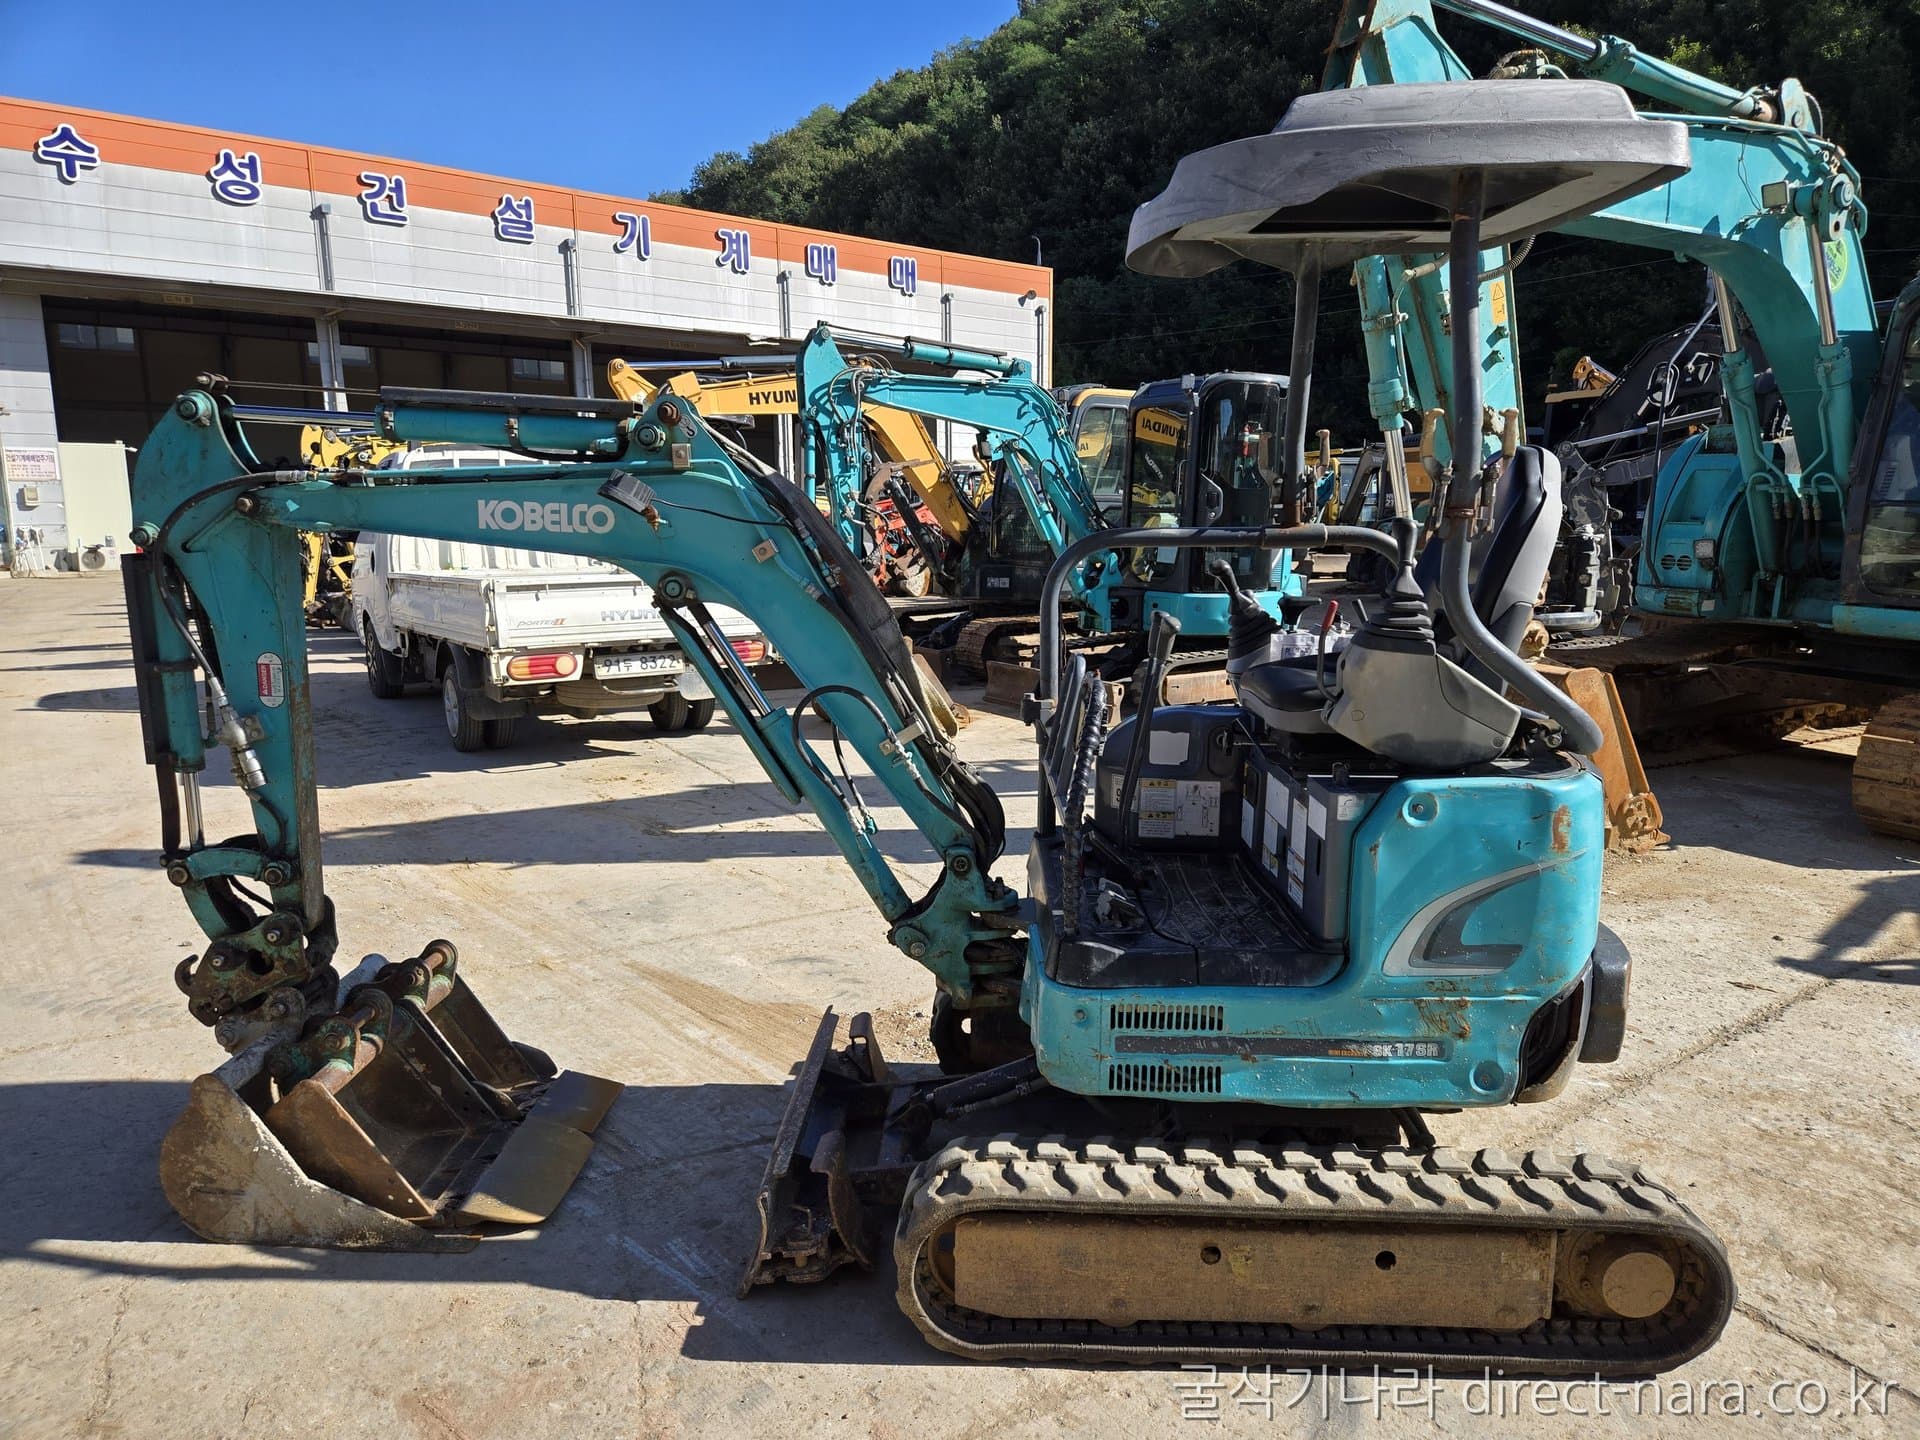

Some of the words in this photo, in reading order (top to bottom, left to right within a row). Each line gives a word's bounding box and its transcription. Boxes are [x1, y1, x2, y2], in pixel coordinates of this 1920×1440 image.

[748, 389, 797, 405] HYUN
[477, 500, 615, 534] KOBELCO
[601, 608, 662, 621] HYUN
[640, 655, 676, 670] 8322
